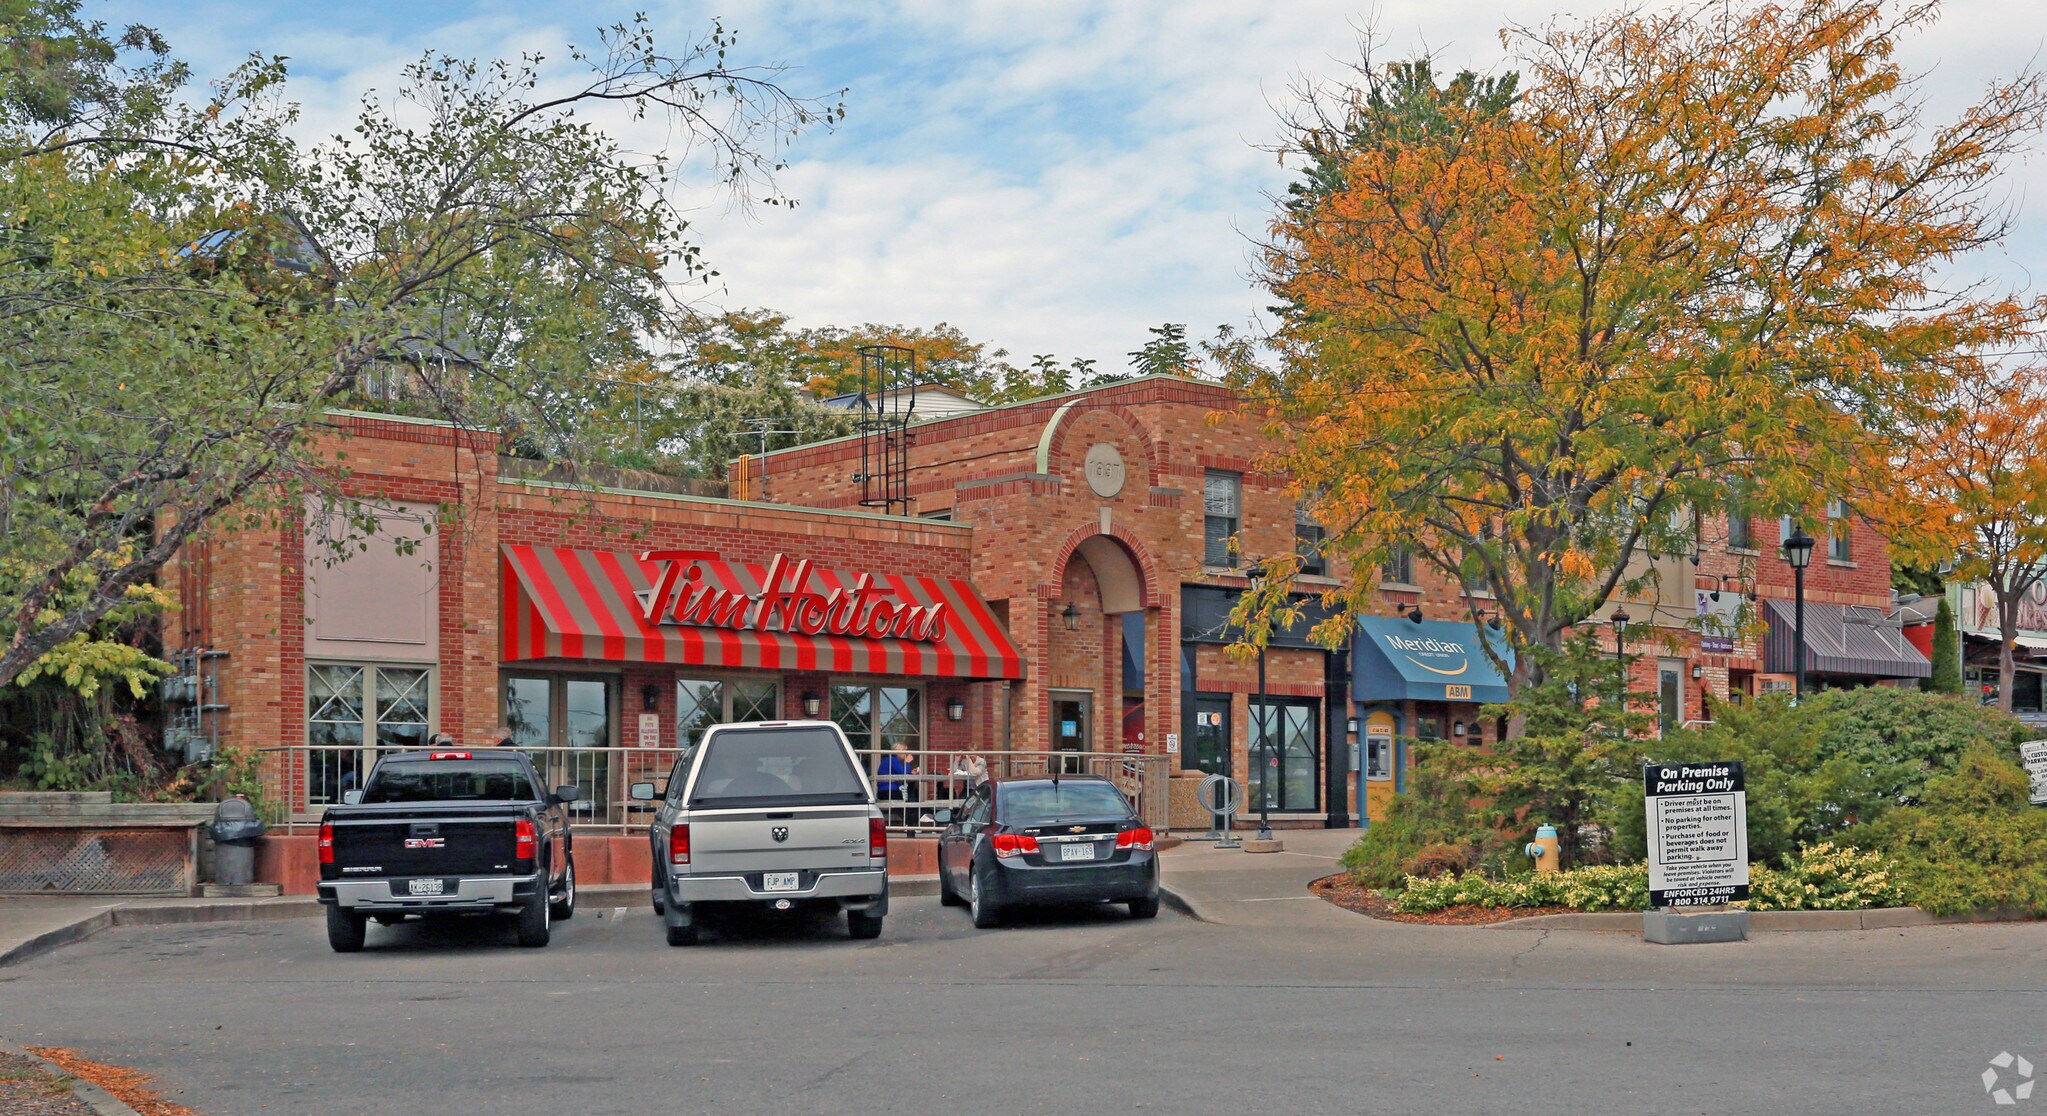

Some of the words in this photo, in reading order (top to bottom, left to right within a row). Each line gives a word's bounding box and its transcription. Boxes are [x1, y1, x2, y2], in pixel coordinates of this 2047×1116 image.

[640, 550, 750, 631] Tim
[751, 553, 949, 643] Hortons
[1384, 635, 1465, 654] Meridian
[1449, 686, 1468, 697] ABM
[1660, 768, 1678, 779] On
[1681, 765, 1729, 778] Premise
[1656, 780, 1704, 793] Parking
[1706, 778, 1734, 791] Only
[1665, 807, 1694, 815] premises
[1676, 816, 1702, 824] parking
[1665, 823, 1702, 832] properties.
[404, 838, 445, 849] GMC
[1666, 840, 1698, 848] beverages
[1667, 846, 1689, 855] permit
[767, 878, 780, 886] FJP
[1663, 888, 1708, 898] ENFORCED
[1708, 886, 1736, 895] 24HRS
[1674, 898, 1691, 906] 800
[1692, 896, 1708, 905] 314
[1710, 895, 1730, 904] 9711
